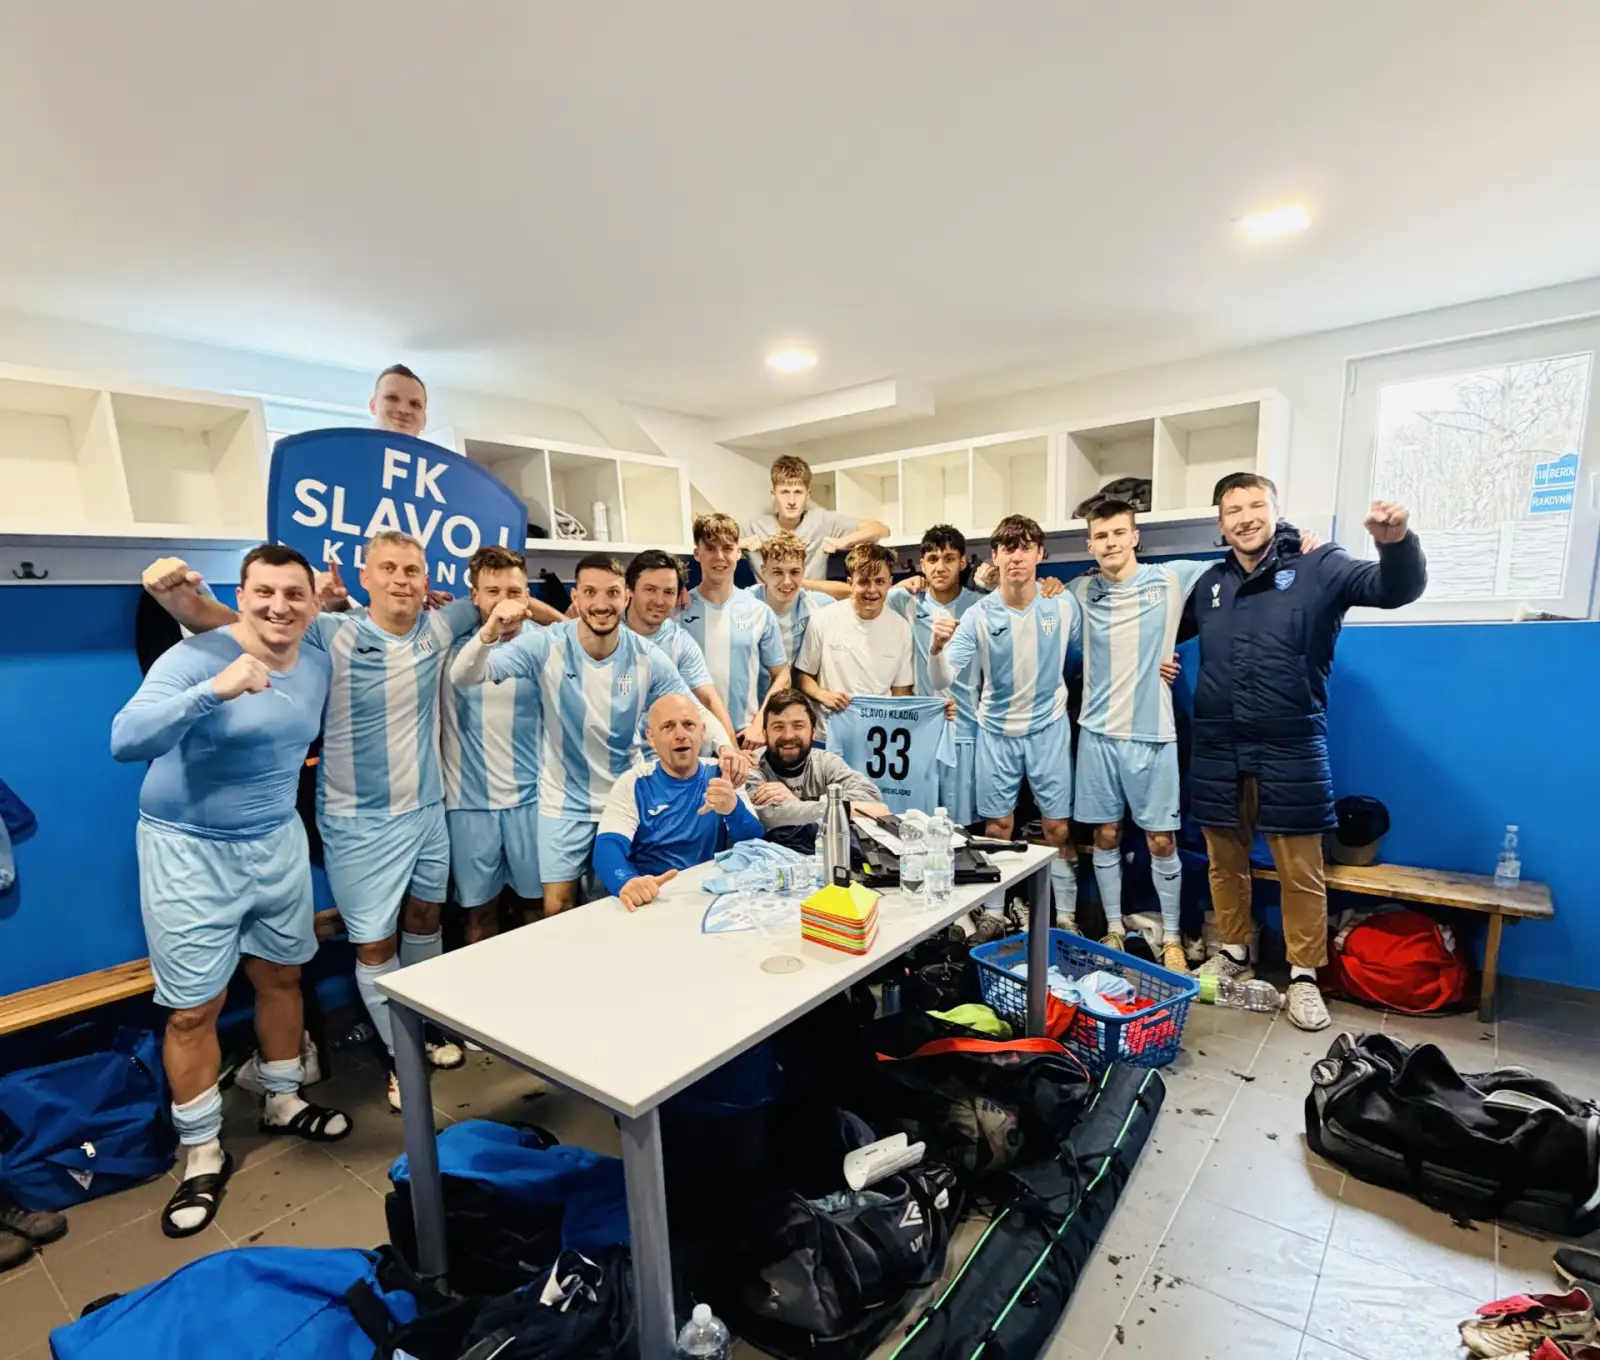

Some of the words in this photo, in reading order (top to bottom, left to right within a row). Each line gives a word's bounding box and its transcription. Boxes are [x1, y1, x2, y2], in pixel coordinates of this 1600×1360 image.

[382, 447, 449, 504] FK
[860, 708, 887, 719] SLAVOJ
[888, 710, 919, 722] KLADNO
[866, 725, 911, 781] 33
